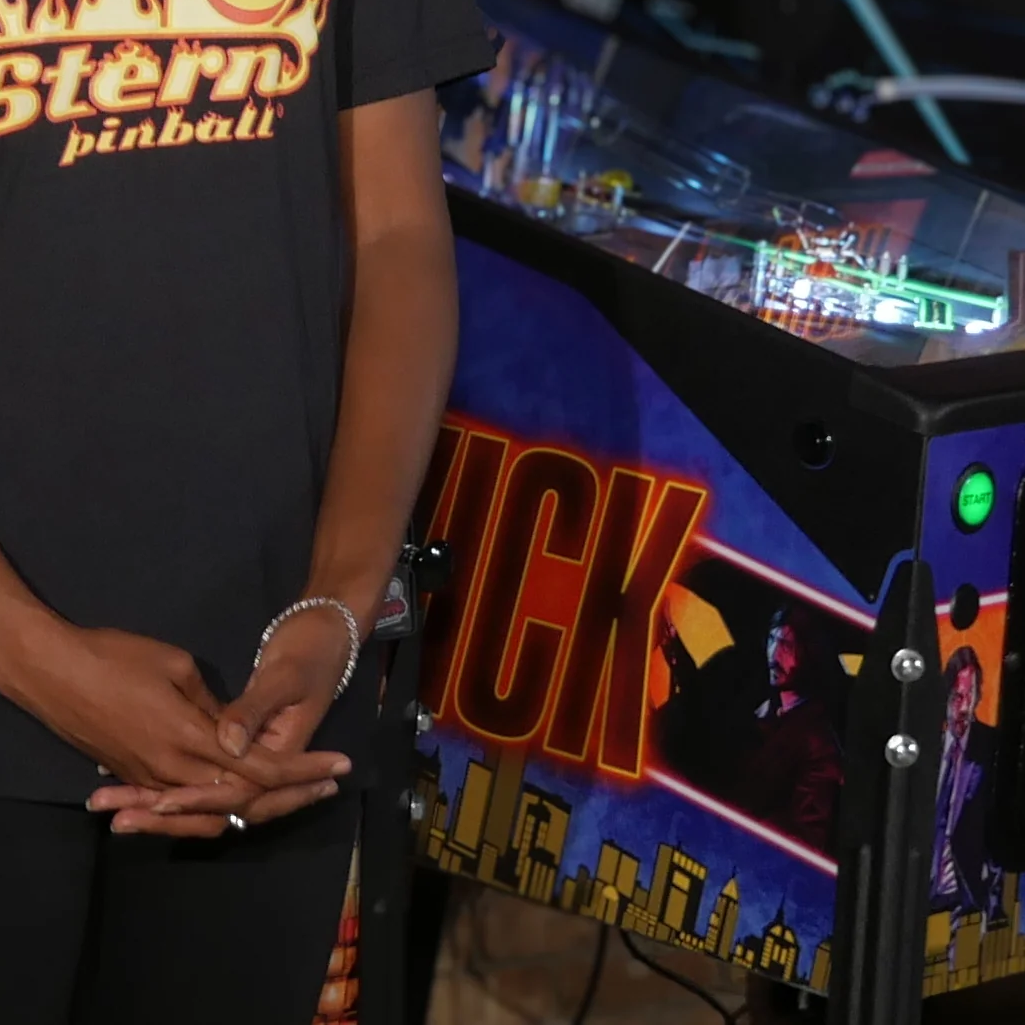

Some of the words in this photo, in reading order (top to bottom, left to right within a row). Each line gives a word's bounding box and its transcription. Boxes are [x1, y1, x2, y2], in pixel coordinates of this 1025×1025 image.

[58, 98, 275, 167] pinball
[962, 492, 991, 507] START
[412, 425, 707, 778] ICK
